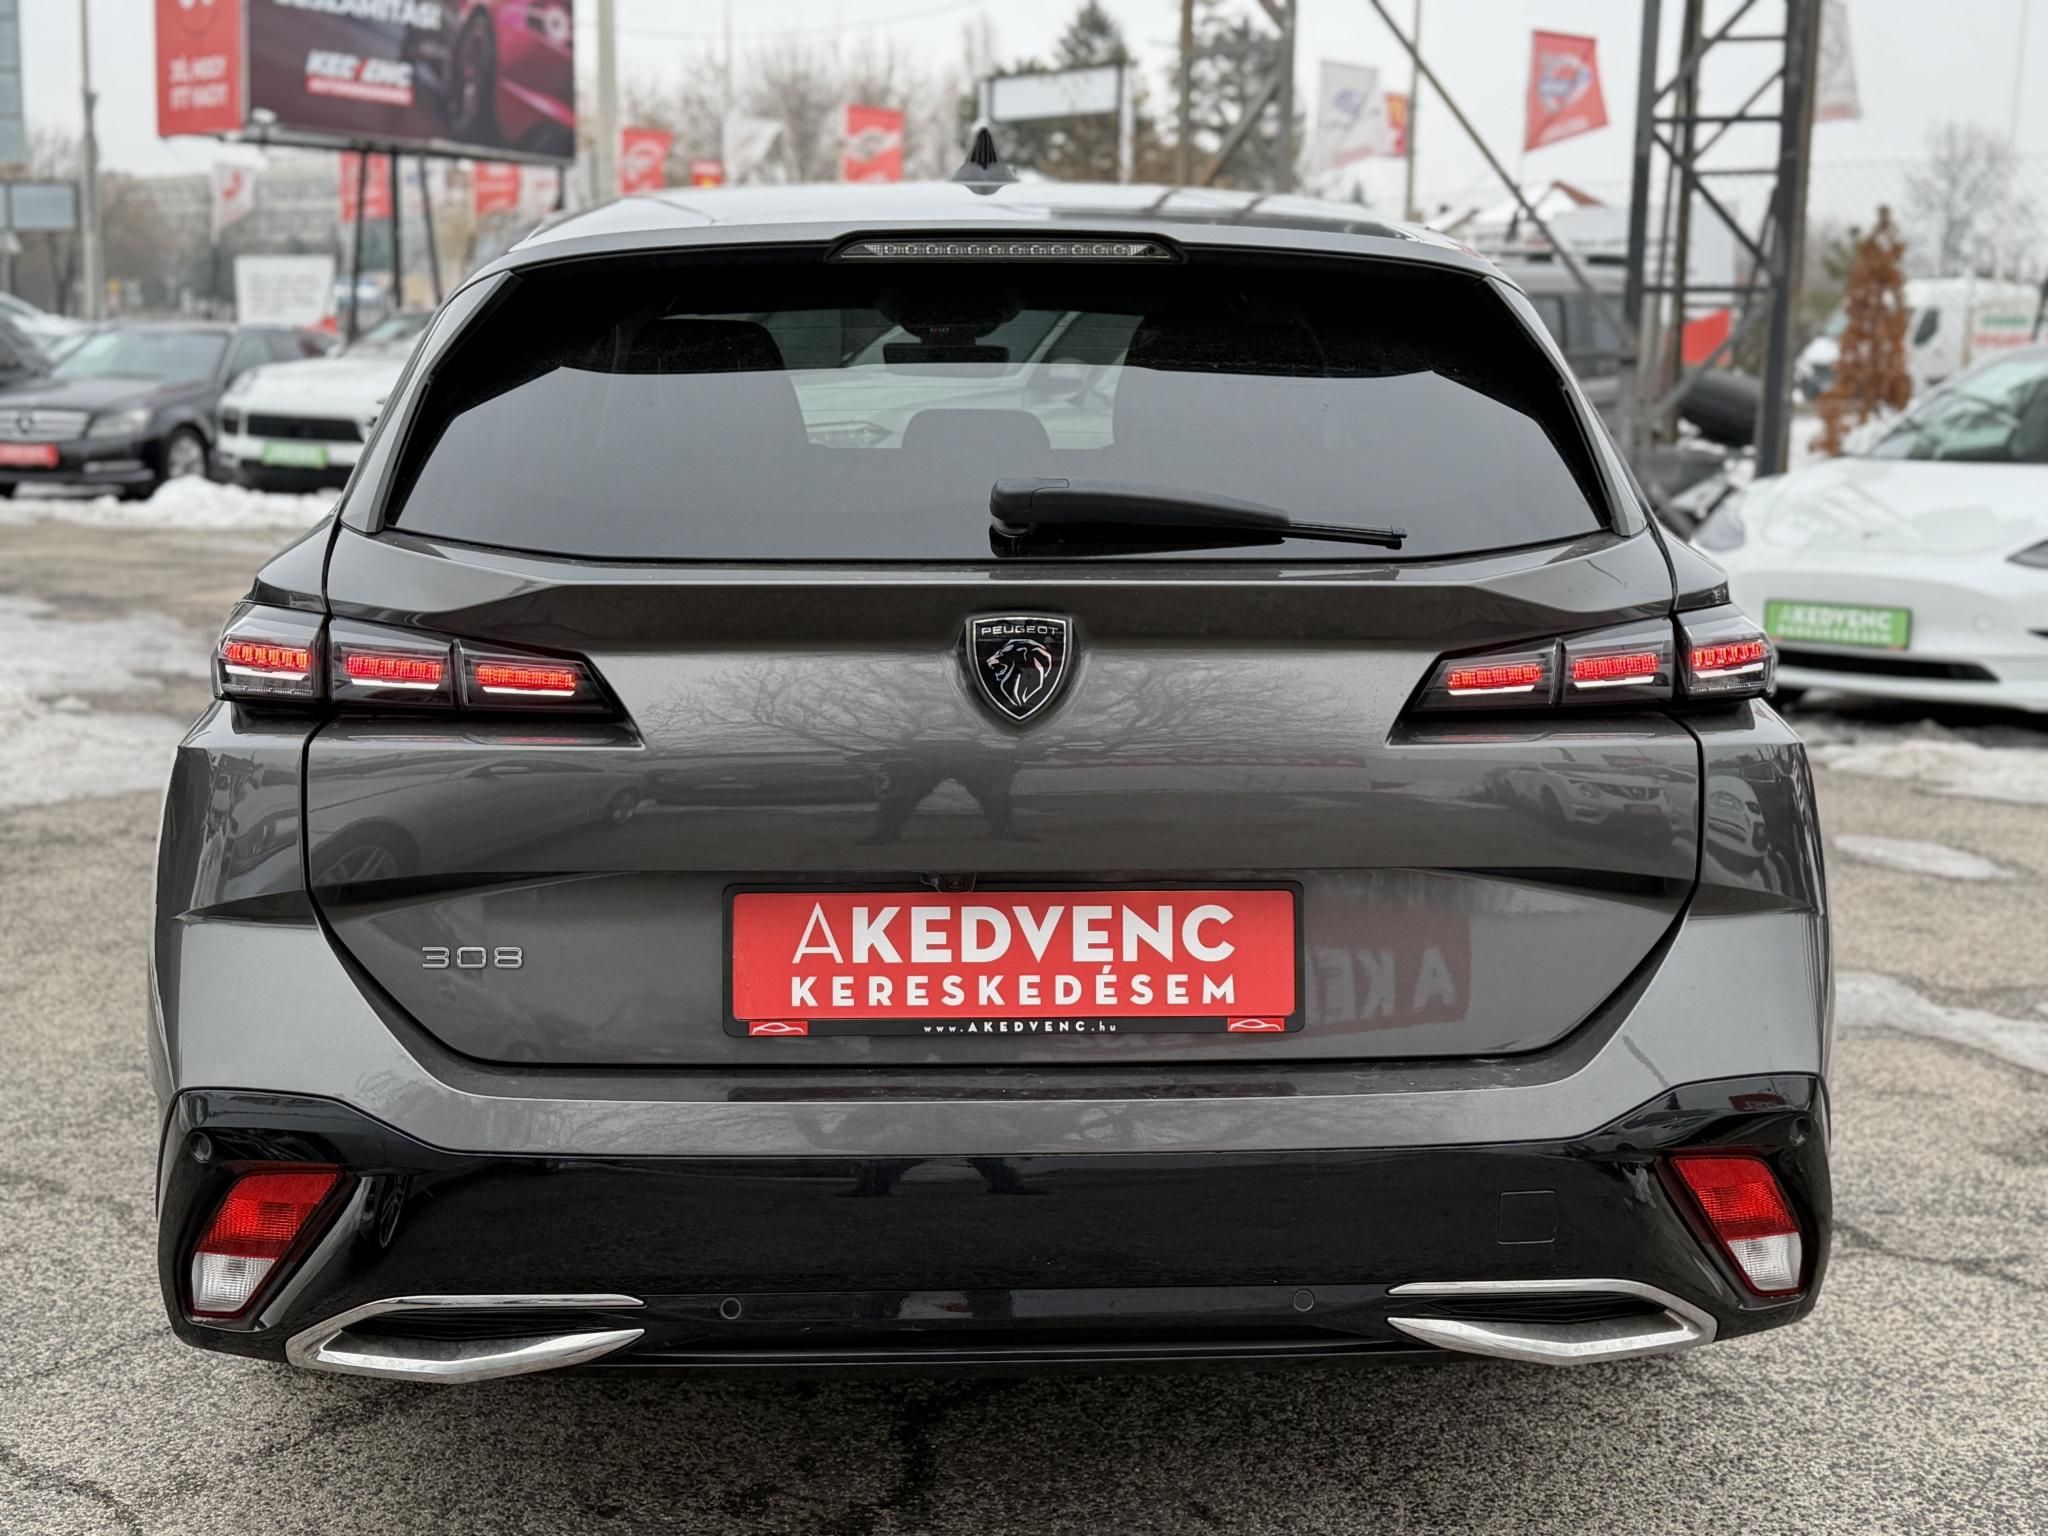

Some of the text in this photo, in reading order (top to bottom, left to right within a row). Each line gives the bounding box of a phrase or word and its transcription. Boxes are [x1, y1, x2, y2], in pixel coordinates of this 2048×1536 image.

[981, 625, 1060, 636] PEUGEOT
[791, 901, 1236, 964] AKEDVENC
[422, 946, 523, 969] 308
[791, 965, 1236, 1007] KERESKEDÉSEM
[923, 1021, 1116, 1033] www.AKEDVENC.hu
